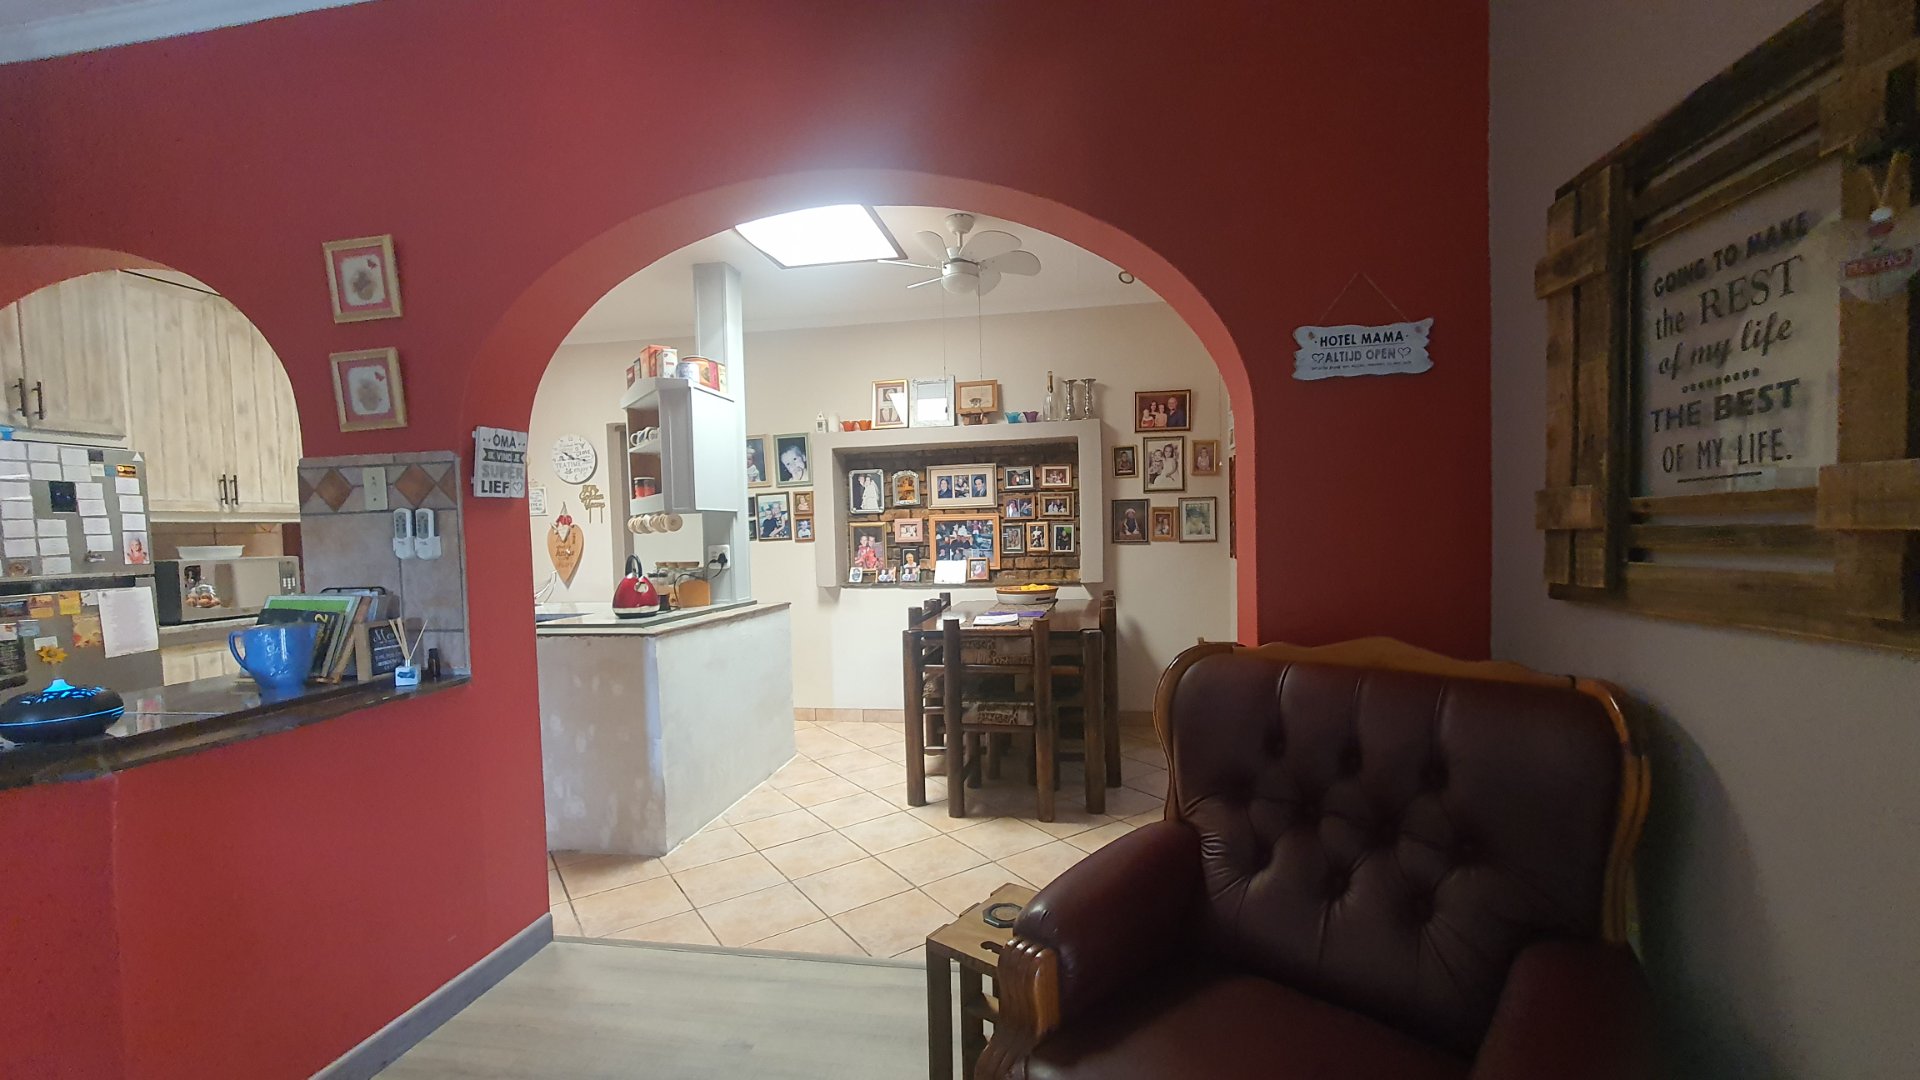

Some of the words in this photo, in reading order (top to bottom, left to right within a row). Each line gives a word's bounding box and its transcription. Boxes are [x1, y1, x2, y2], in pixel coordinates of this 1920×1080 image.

[1654, 259, 1708, 298] GOING
[1712, 242, 1739, 271] TO
[1744, 210, 1809, 259] MAKE
[1655, 304, 1687, 341] the
[1698, 255, 1803, 326] REST
[1320, 334, 1356, 347] HOTEL
[1361, 331, 1404, 344] MAMA
[1658, 340, 1683, 380] of
[1690, 333, 1733, 370] my
[1740, 311, 1793, 357] life
[1325, 350, 1361, 363] ALTIJD
[1366, 348, 1396, 360] OPEN
[1650, 399, 1702, 433] THE
[1713, 378, 1801, 424] BEST
[492, 433, 516, 449] OMA
[1662, 442, 1685, 474] OF
[1697, 437, 1724, 470] MY
[1736, 426, 1793, 469] LIFE.
[481, 464, 524, 480] SUPER
[481, 479, 510, 493] LIEF
